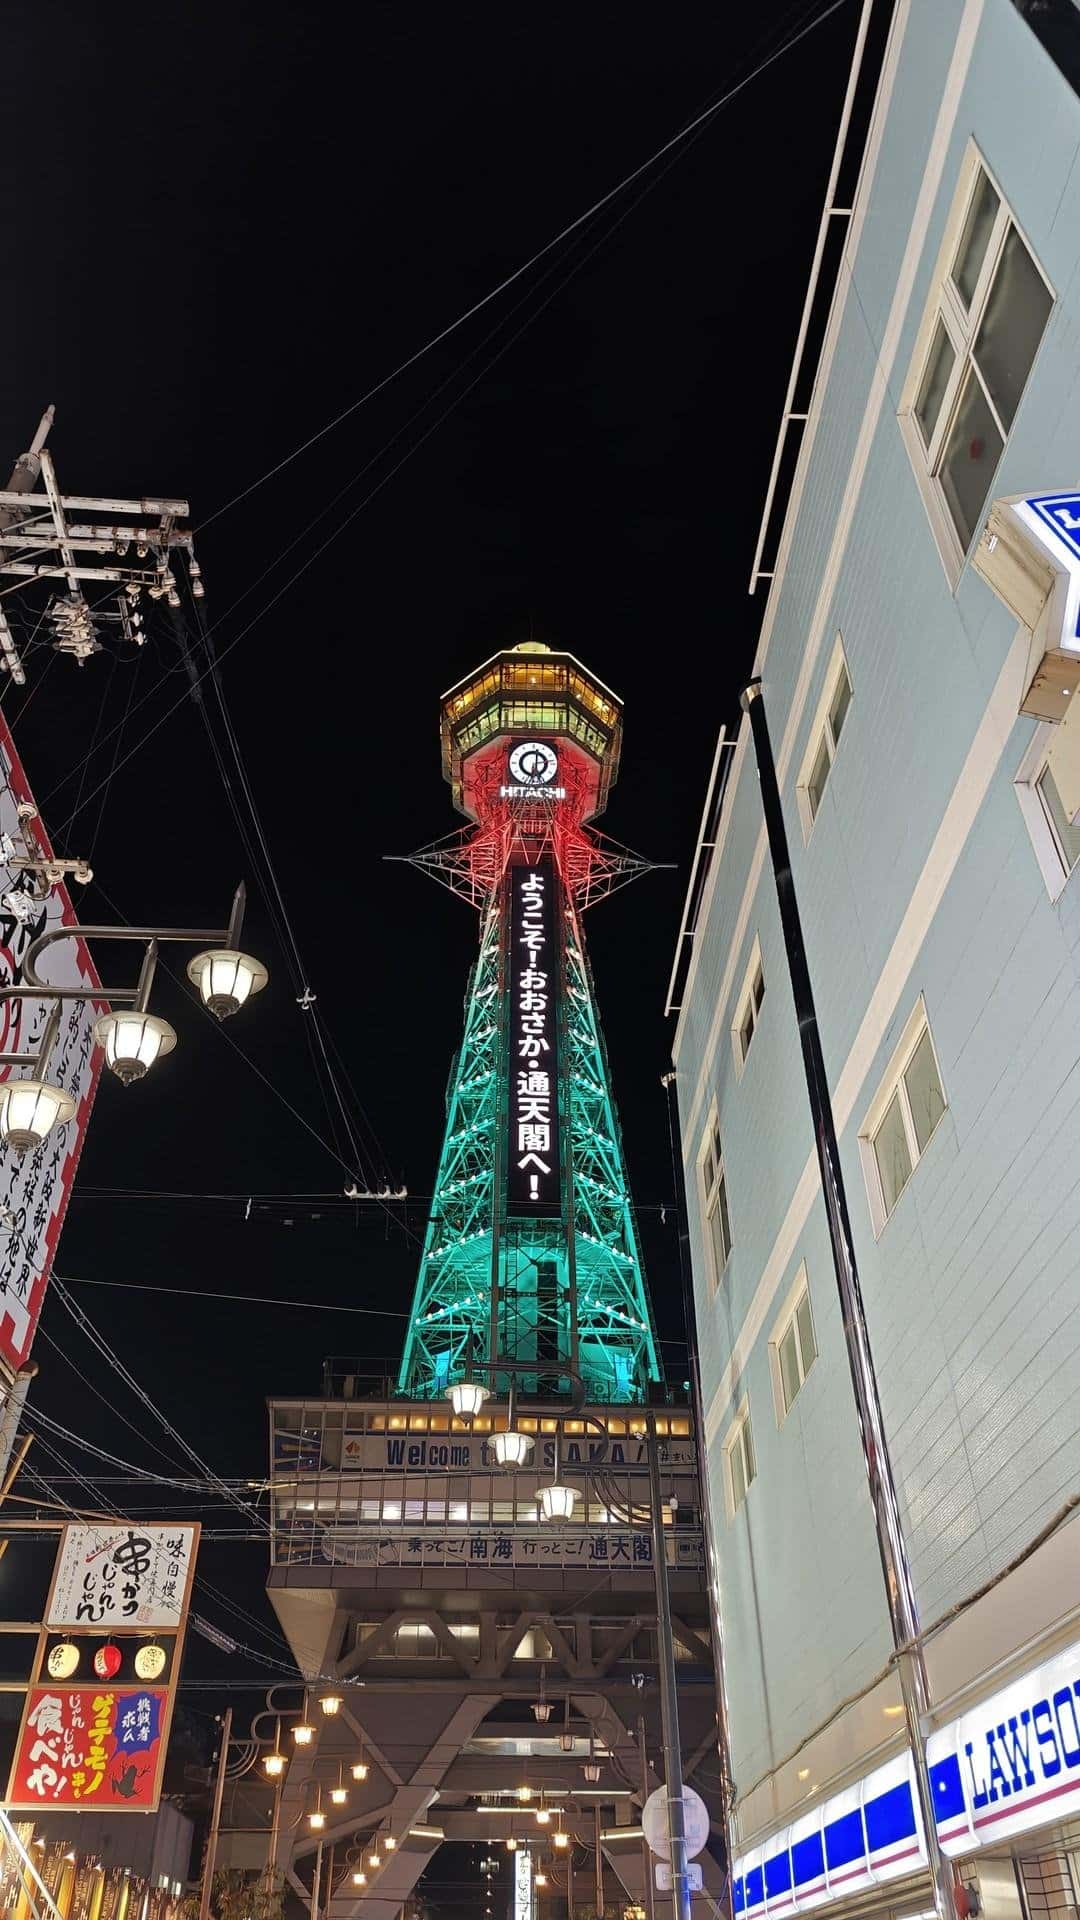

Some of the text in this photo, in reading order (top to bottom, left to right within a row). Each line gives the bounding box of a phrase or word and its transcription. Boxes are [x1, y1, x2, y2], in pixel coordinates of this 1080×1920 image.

[501, 786, 566, 799] HITACHI
[387, 1440, 469, 1466] Welcome
[99, 1563, 118, 1610] じゃん
[112, 1531, 152, 1617] 串かつ
[162, 1533, 186, 1599] 味自慢
[75, 1572, 105, 1622] じゃん
[69, 1693, 85, 1729] じゃん
[61, 1728, 83, 1769] じゃん
[84, 1692, 115, 1795] ゲテモノ
[965, 1680, 1080, 1810] LAWSO
